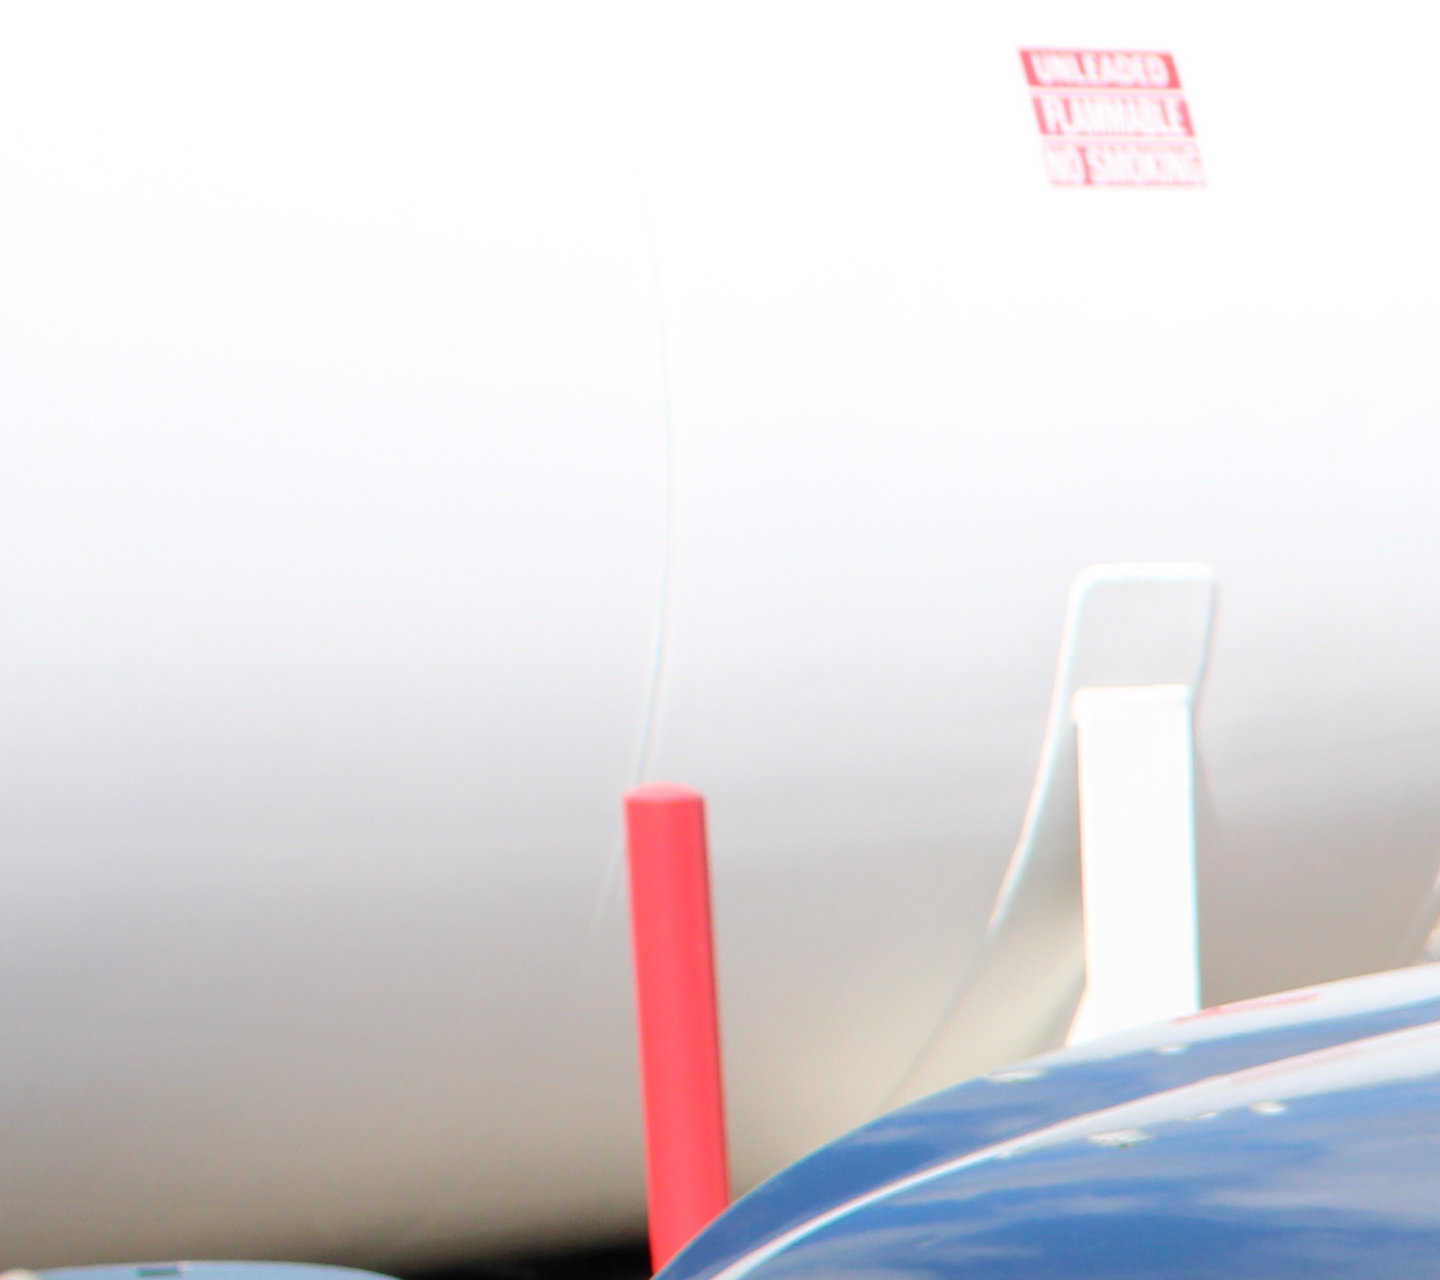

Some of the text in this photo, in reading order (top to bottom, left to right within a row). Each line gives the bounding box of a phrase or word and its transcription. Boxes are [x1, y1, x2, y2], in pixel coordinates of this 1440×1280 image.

[1029, 51, 1169, 85] UNLEADED
[1041, 97, 1188, 135] FLAMMABLE
[1045, 147, 1086, 183] NO
